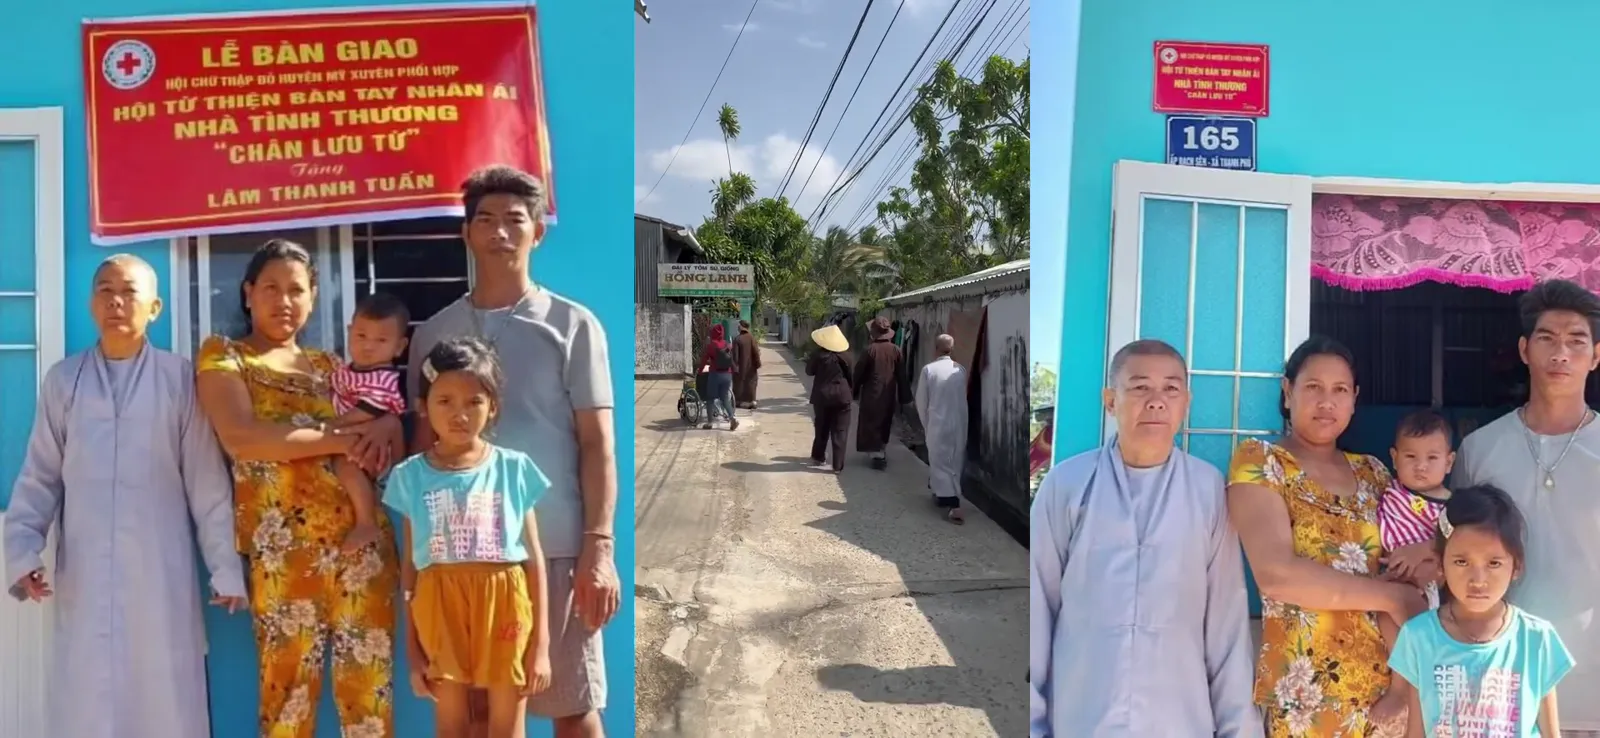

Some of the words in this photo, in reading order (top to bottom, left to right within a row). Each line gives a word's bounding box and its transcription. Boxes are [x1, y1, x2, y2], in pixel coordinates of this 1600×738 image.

[202, 39, 241, 68] LỄ
[252, 40, 325, 66] BÀN
[336, 38, 418, 62] GIAO
[165, 76, 187, 92] HỘI
[191, 75, 218, 87] CHỮ
[219, 73, 254, 88] THẬP
[350, 66, 394, 80] XUYÊN
[397, 63, 428, 77] PHỐI
[432, 64, 459, 78] HỢP
[113, 102, 156, 122] HỘI
[163, 96, 198, 115] TỪ
[203, 92, 281, 111] THIỆN
[289, 88, 345, 105] BÀN
[353, 86, 399, 101] TAY
[406, 83, 484, 99] NHÂN
[492, 82, 517, 100] ÁI
[173, 114, 239, 139] NHÀ
[248, 111, 320, 133] TÌNH
[329, 105, 459, 126] THƯƠNG
[312, 134, 363, 158] LƯU
[1183, 126, 1240, 151] 165
[207, 188, 261, 208] LÂM
[269, 180, 356, 201] THANH
[364, 170, 435, 193] TUẤN
